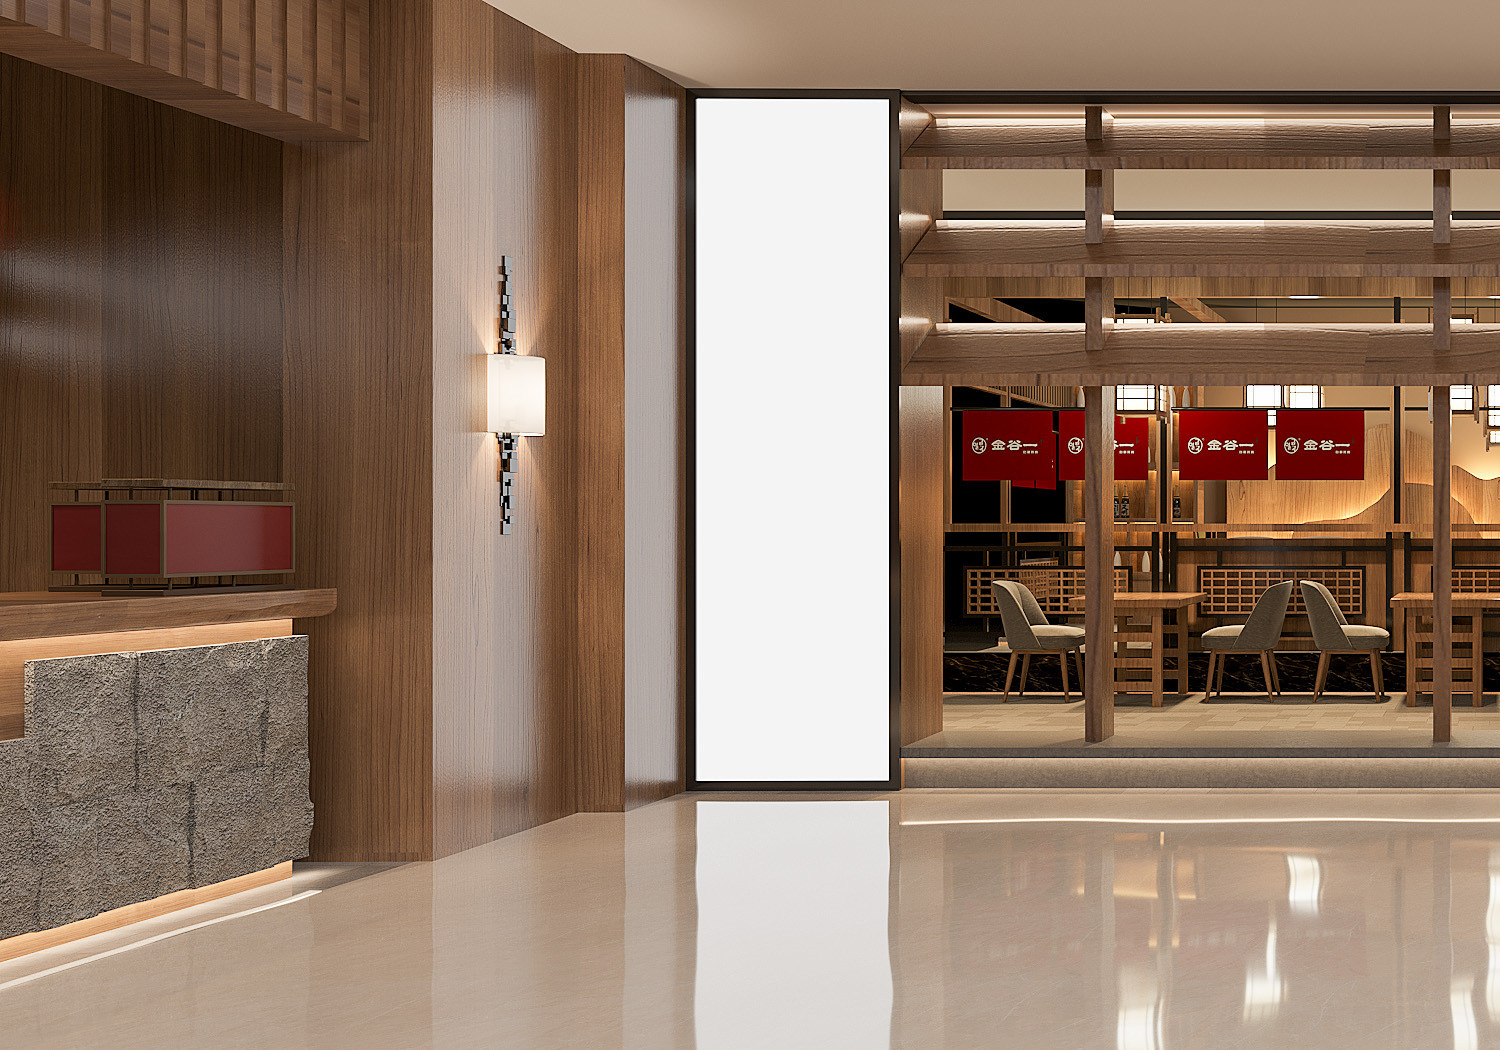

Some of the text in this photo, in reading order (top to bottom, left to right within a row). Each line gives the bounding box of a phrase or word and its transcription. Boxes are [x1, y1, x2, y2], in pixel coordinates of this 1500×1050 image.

[990, 439, 1038, 450] 金谷一
[1206, 439, 1254, 450] 金谷一
[1303, 439, 1350, 450] 金谷一
